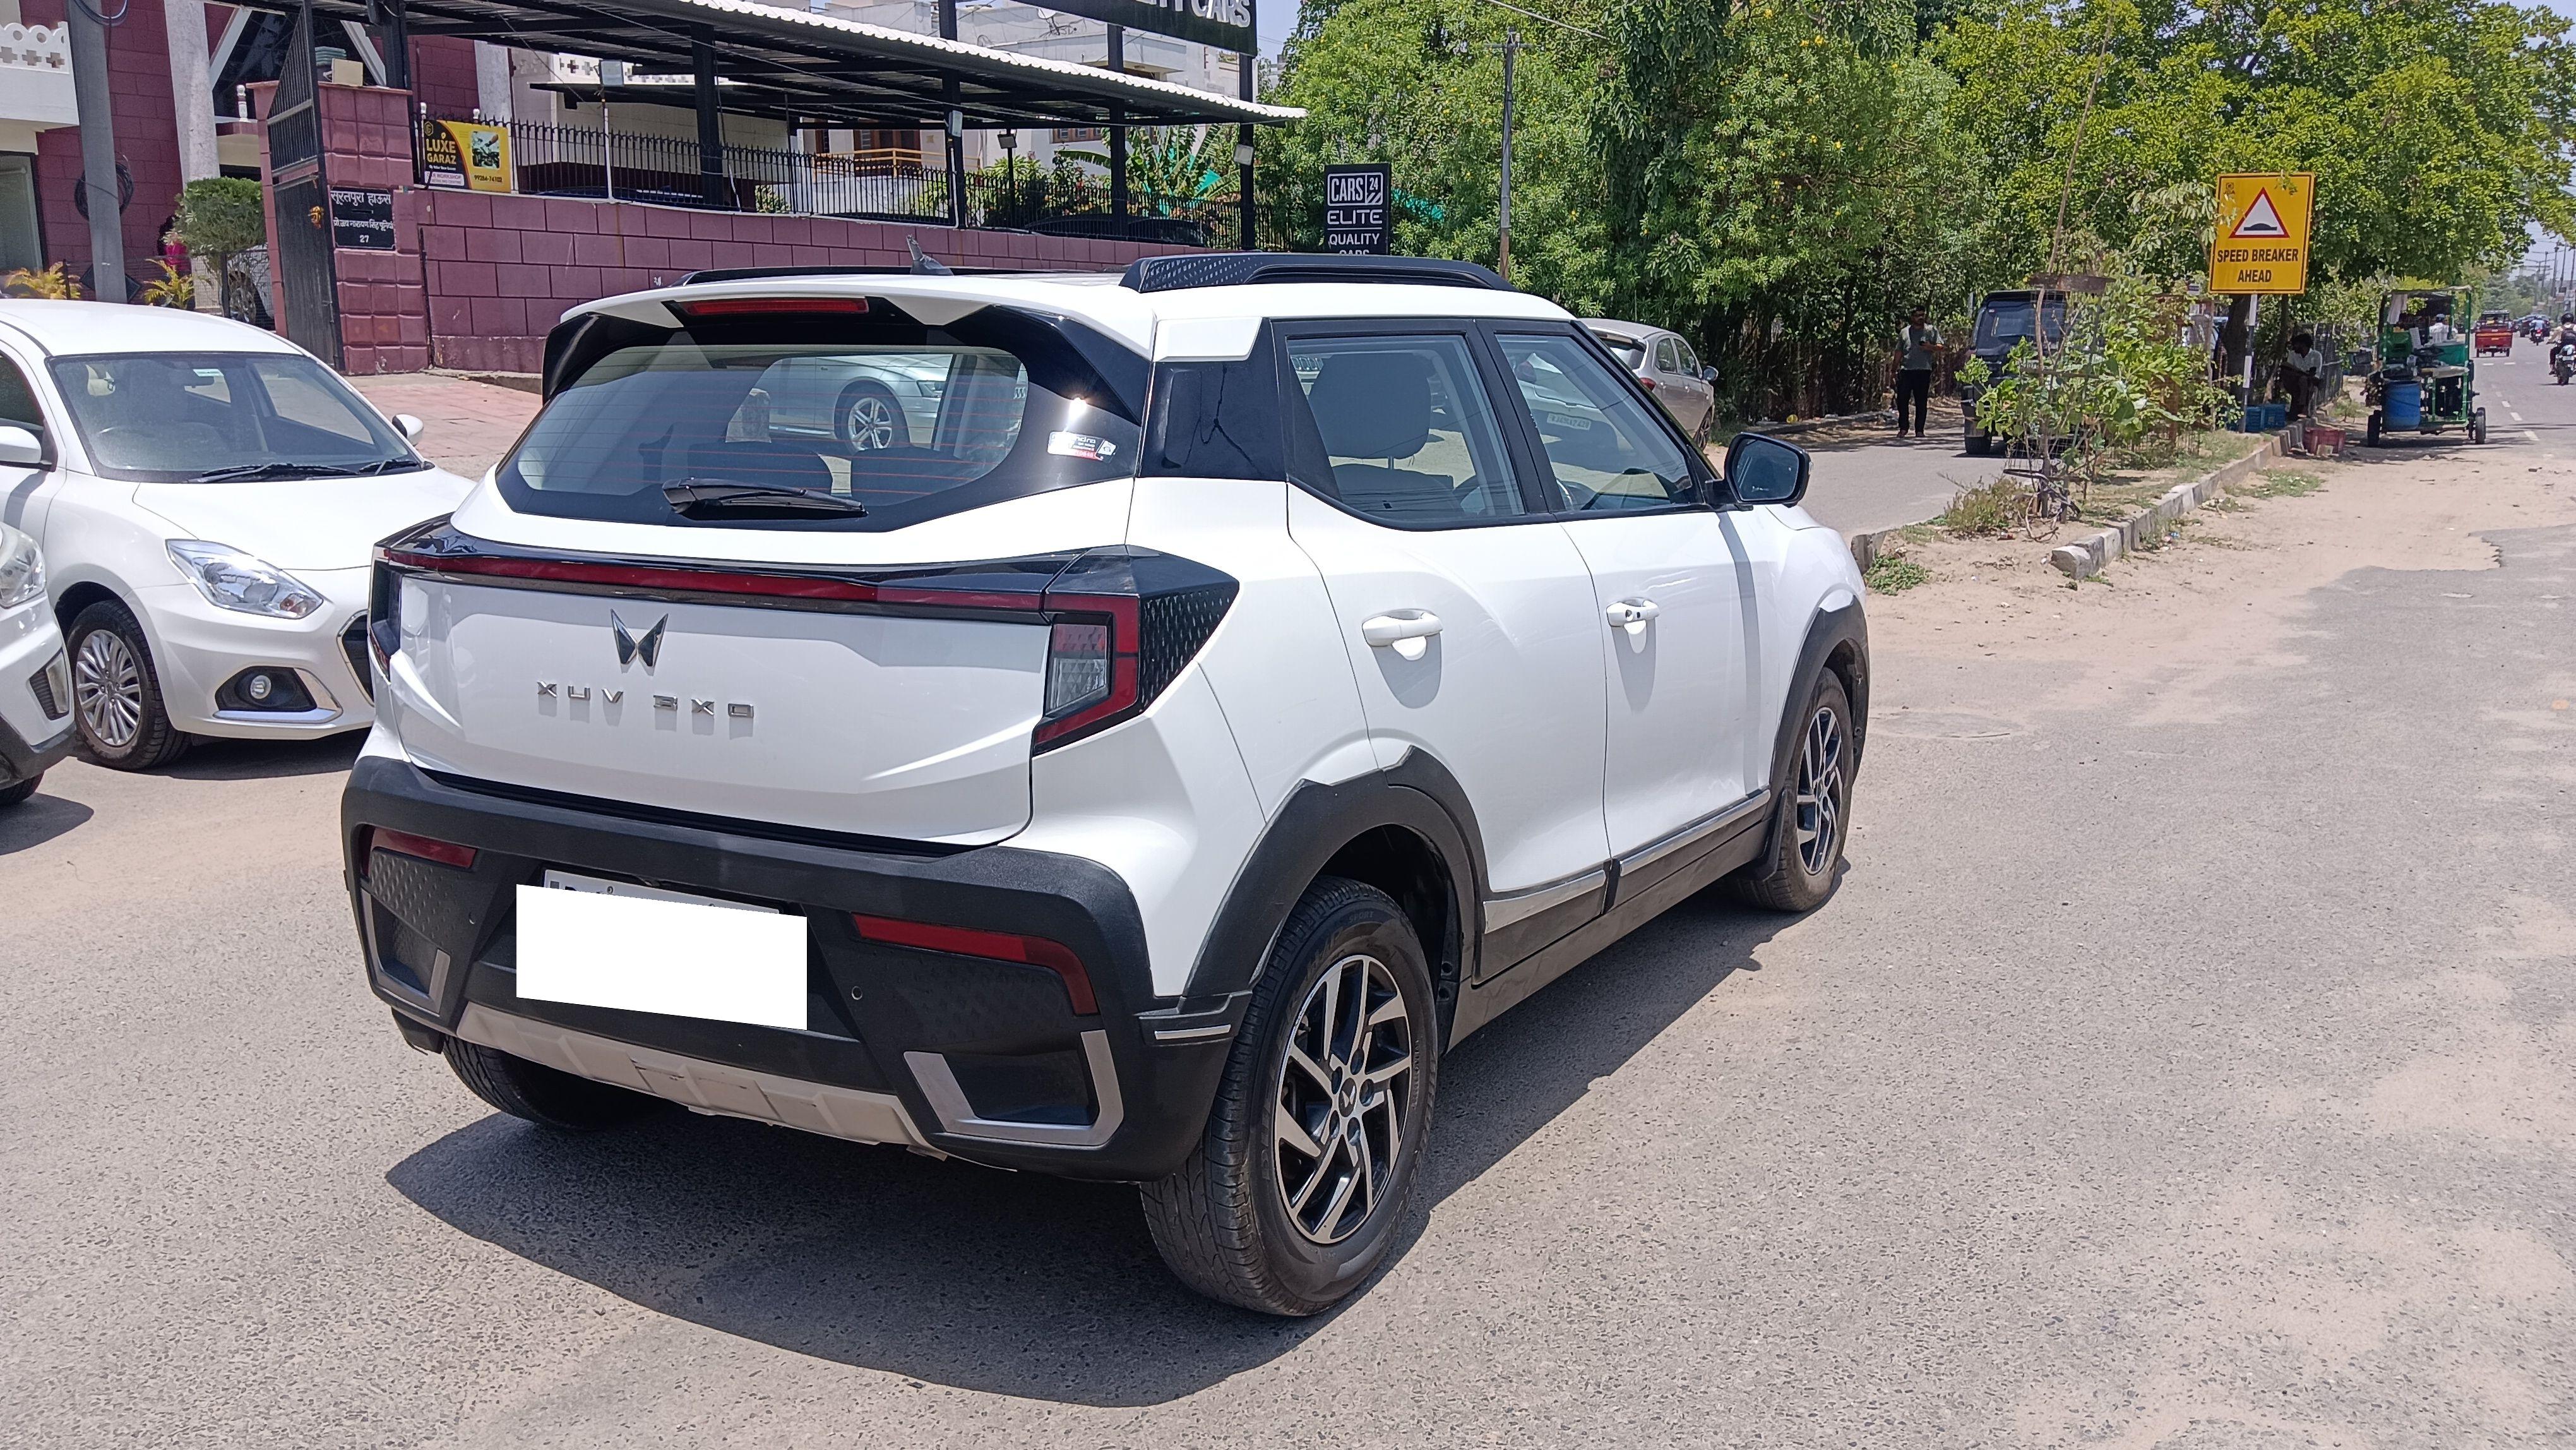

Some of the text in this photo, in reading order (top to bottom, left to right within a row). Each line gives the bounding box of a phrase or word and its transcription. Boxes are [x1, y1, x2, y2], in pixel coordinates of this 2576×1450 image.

[426, 138, 456, 153] LUXE
[427, 153, 456, 164] GARAZ
[1331, 177, 1379, 201] CARS 24
[1327, 210, 1383, 224] ELITE
[359, 234, 369, 243] 27
[1329, 233, 1380, 246] QUALITY
[2217, 248, 2299, 263] SPEED BREAKER
[2237, 270, 2272, 282] AHEAD
[537, 680, 624, 703] XUV
[1349, 911, 1374, 923] SPORT
